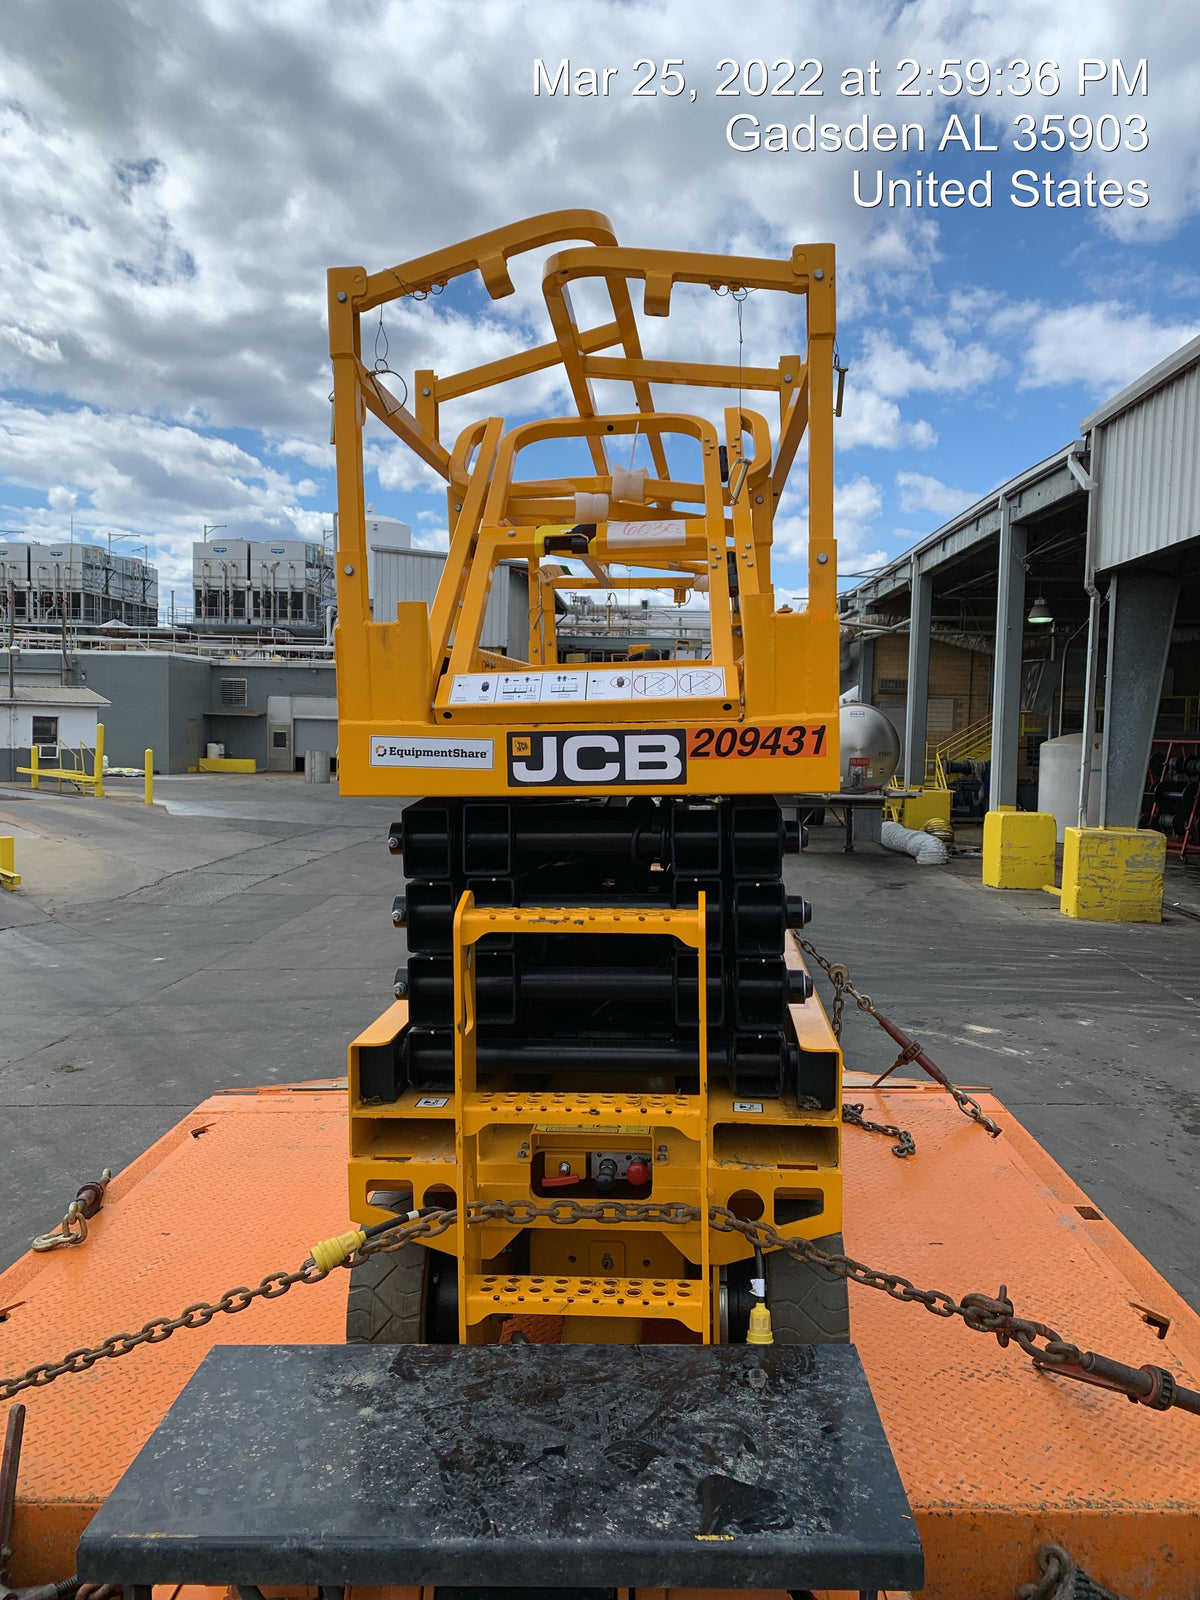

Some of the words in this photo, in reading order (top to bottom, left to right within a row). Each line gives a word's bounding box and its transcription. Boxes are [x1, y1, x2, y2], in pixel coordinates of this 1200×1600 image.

[389, 747, 487, 759] EquipmentShare
[512, 734, 682, 782] JCB
[689, 725, 826, 758] 209431
